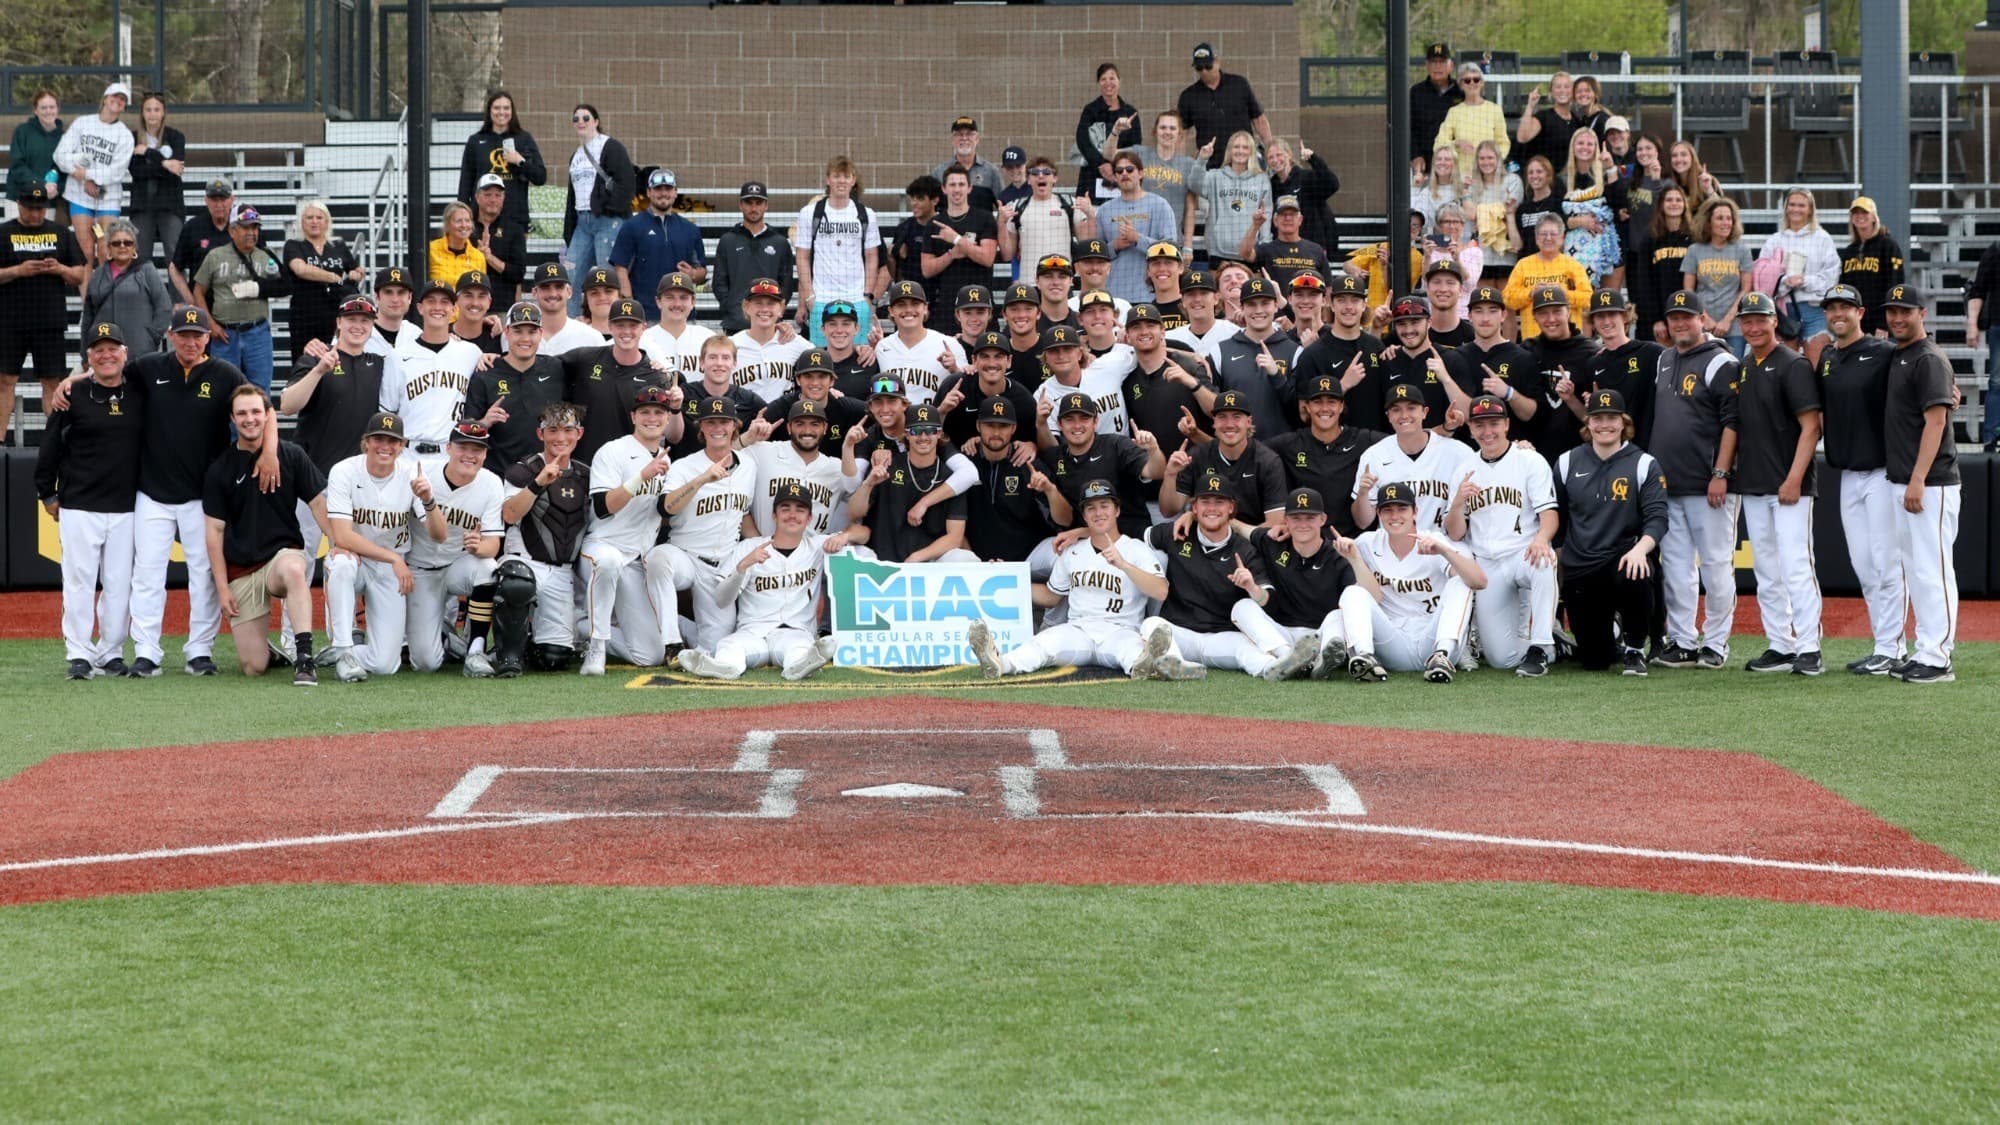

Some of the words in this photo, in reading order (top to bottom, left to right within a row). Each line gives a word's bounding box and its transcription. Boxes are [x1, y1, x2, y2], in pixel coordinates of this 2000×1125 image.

[80, 134, 117, 153] GUSTAVU
[1219, 188, 1258, 203] GUSTAVUS
[819, 222, 860, 234] GUSTAVUS
[10, 234, 57, 244] GUSTAVUS
[814, 513, 830, 531] 14
[1514, 515, 1522, 534] 4
[857, 575, 1020, 622] MIAC
[854, 631, 935, 642] REGULAR
[943, 631, 1011, 642] SEAON
